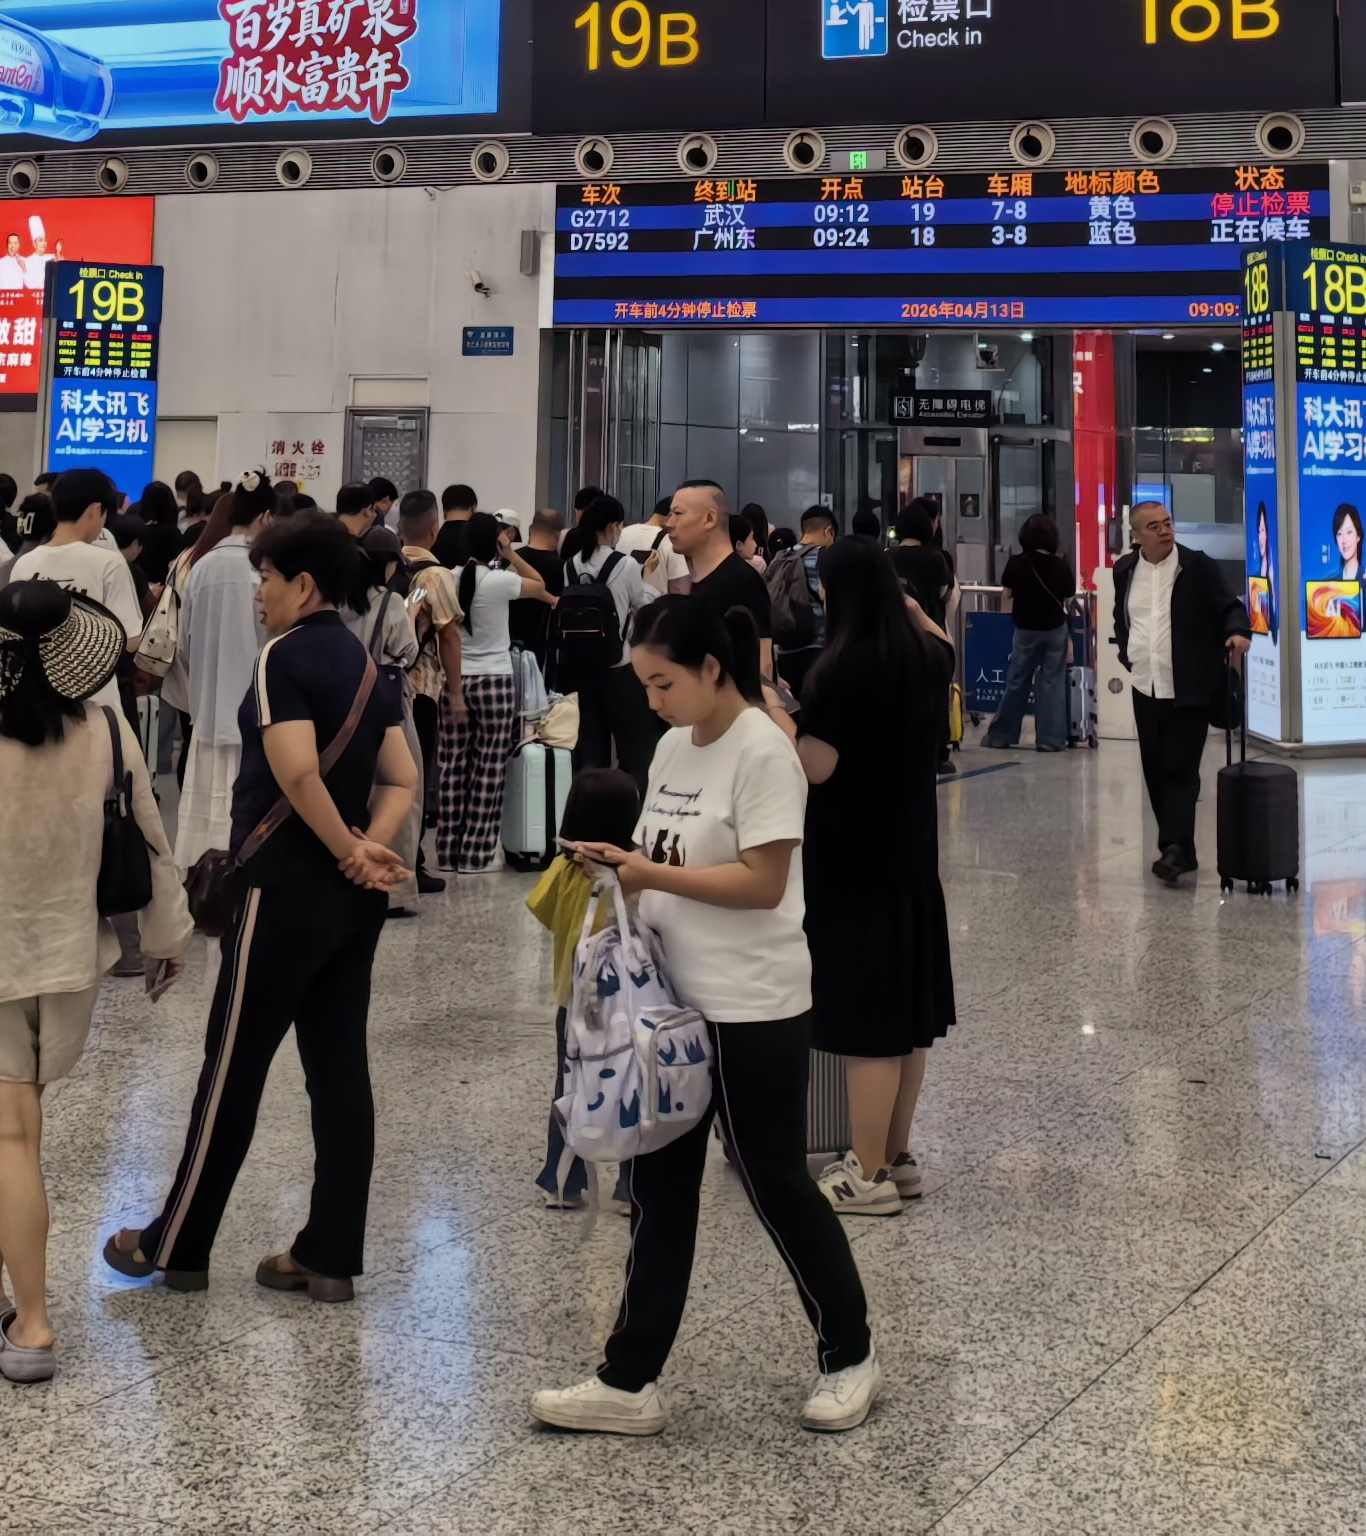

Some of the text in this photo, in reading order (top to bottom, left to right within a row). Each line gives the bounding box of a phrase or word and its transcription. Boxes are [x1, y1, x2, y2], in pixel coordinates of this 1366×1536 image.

[574, 0, 699, 70] 19B
[897, 27, 982, 48] Check in
[222, 46, 401, 114] 顺水富贵年
[581, 166, 1284, 206] 车次 终到站 开点 站台 车厢 地标颜色 状态
[571, 191, 1311, 228] G2712 武汉 09:12 19 7-8 黄色 停止检票
[570, 218, 1311, 251] D7592 广州东 09:24 18 3-8 蓝色 正在候车
[109, 269, 134, 280] Check
[136, 271, 144, 281] in
[1245, 263, 1269, 315] 18B
[69, 279, 145, 322] 19B
[614, 301, 757, 320] 开车前4分钟停止检票
[901, 301, 1025, 320] 2026年04月13日
[61, 389, 149, 416] 科大讯飞
[56, 417, 148, 443] AI学习机
[271, 439, 325, 455] 消火栓
[976, 667, 1006, 683] 人工
